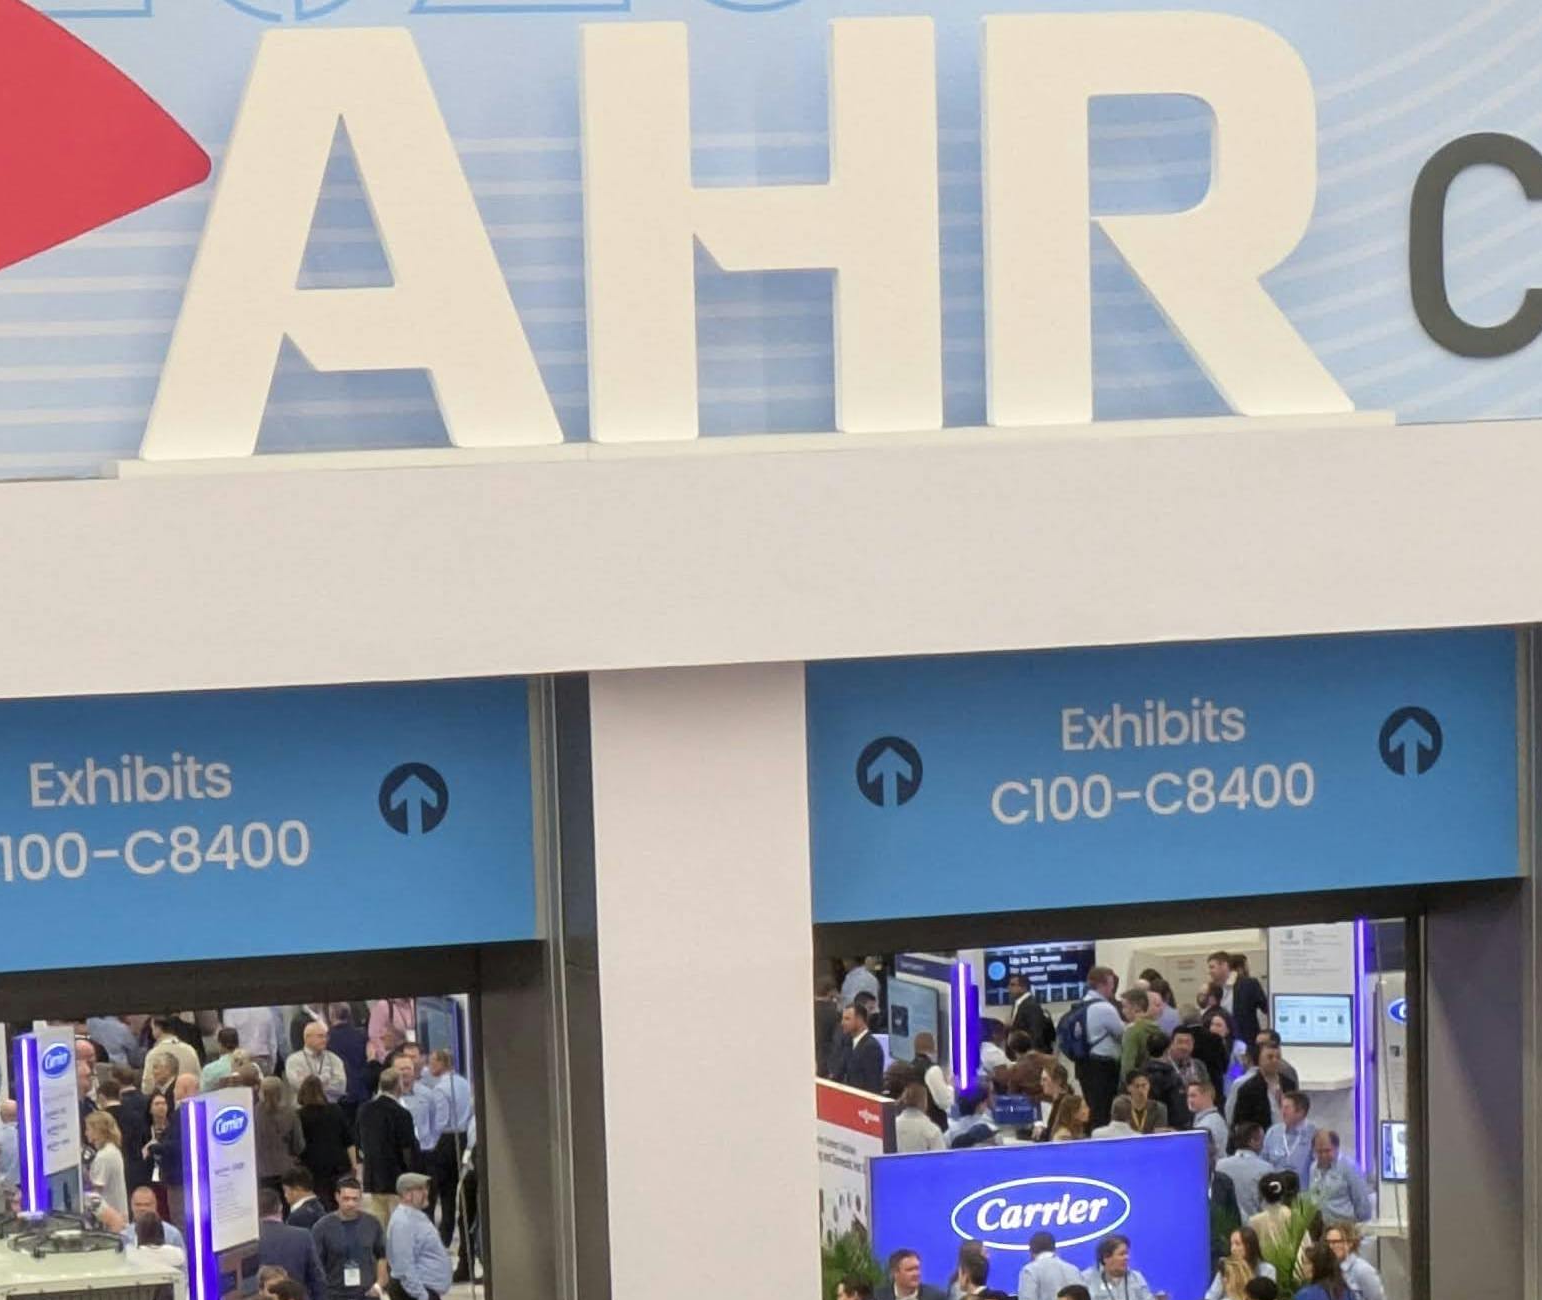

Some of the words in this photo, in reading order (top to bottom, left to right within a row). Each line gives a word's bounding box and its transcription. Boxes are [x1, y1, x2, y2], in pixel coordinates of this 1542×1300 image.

[139, 10, 1356, 461] AHR
[1061, 697, 1246, 752] Exhibits
[28, 752, 234, 809] Exhibits
[976, 1193, 1109, 1231] Carrier
